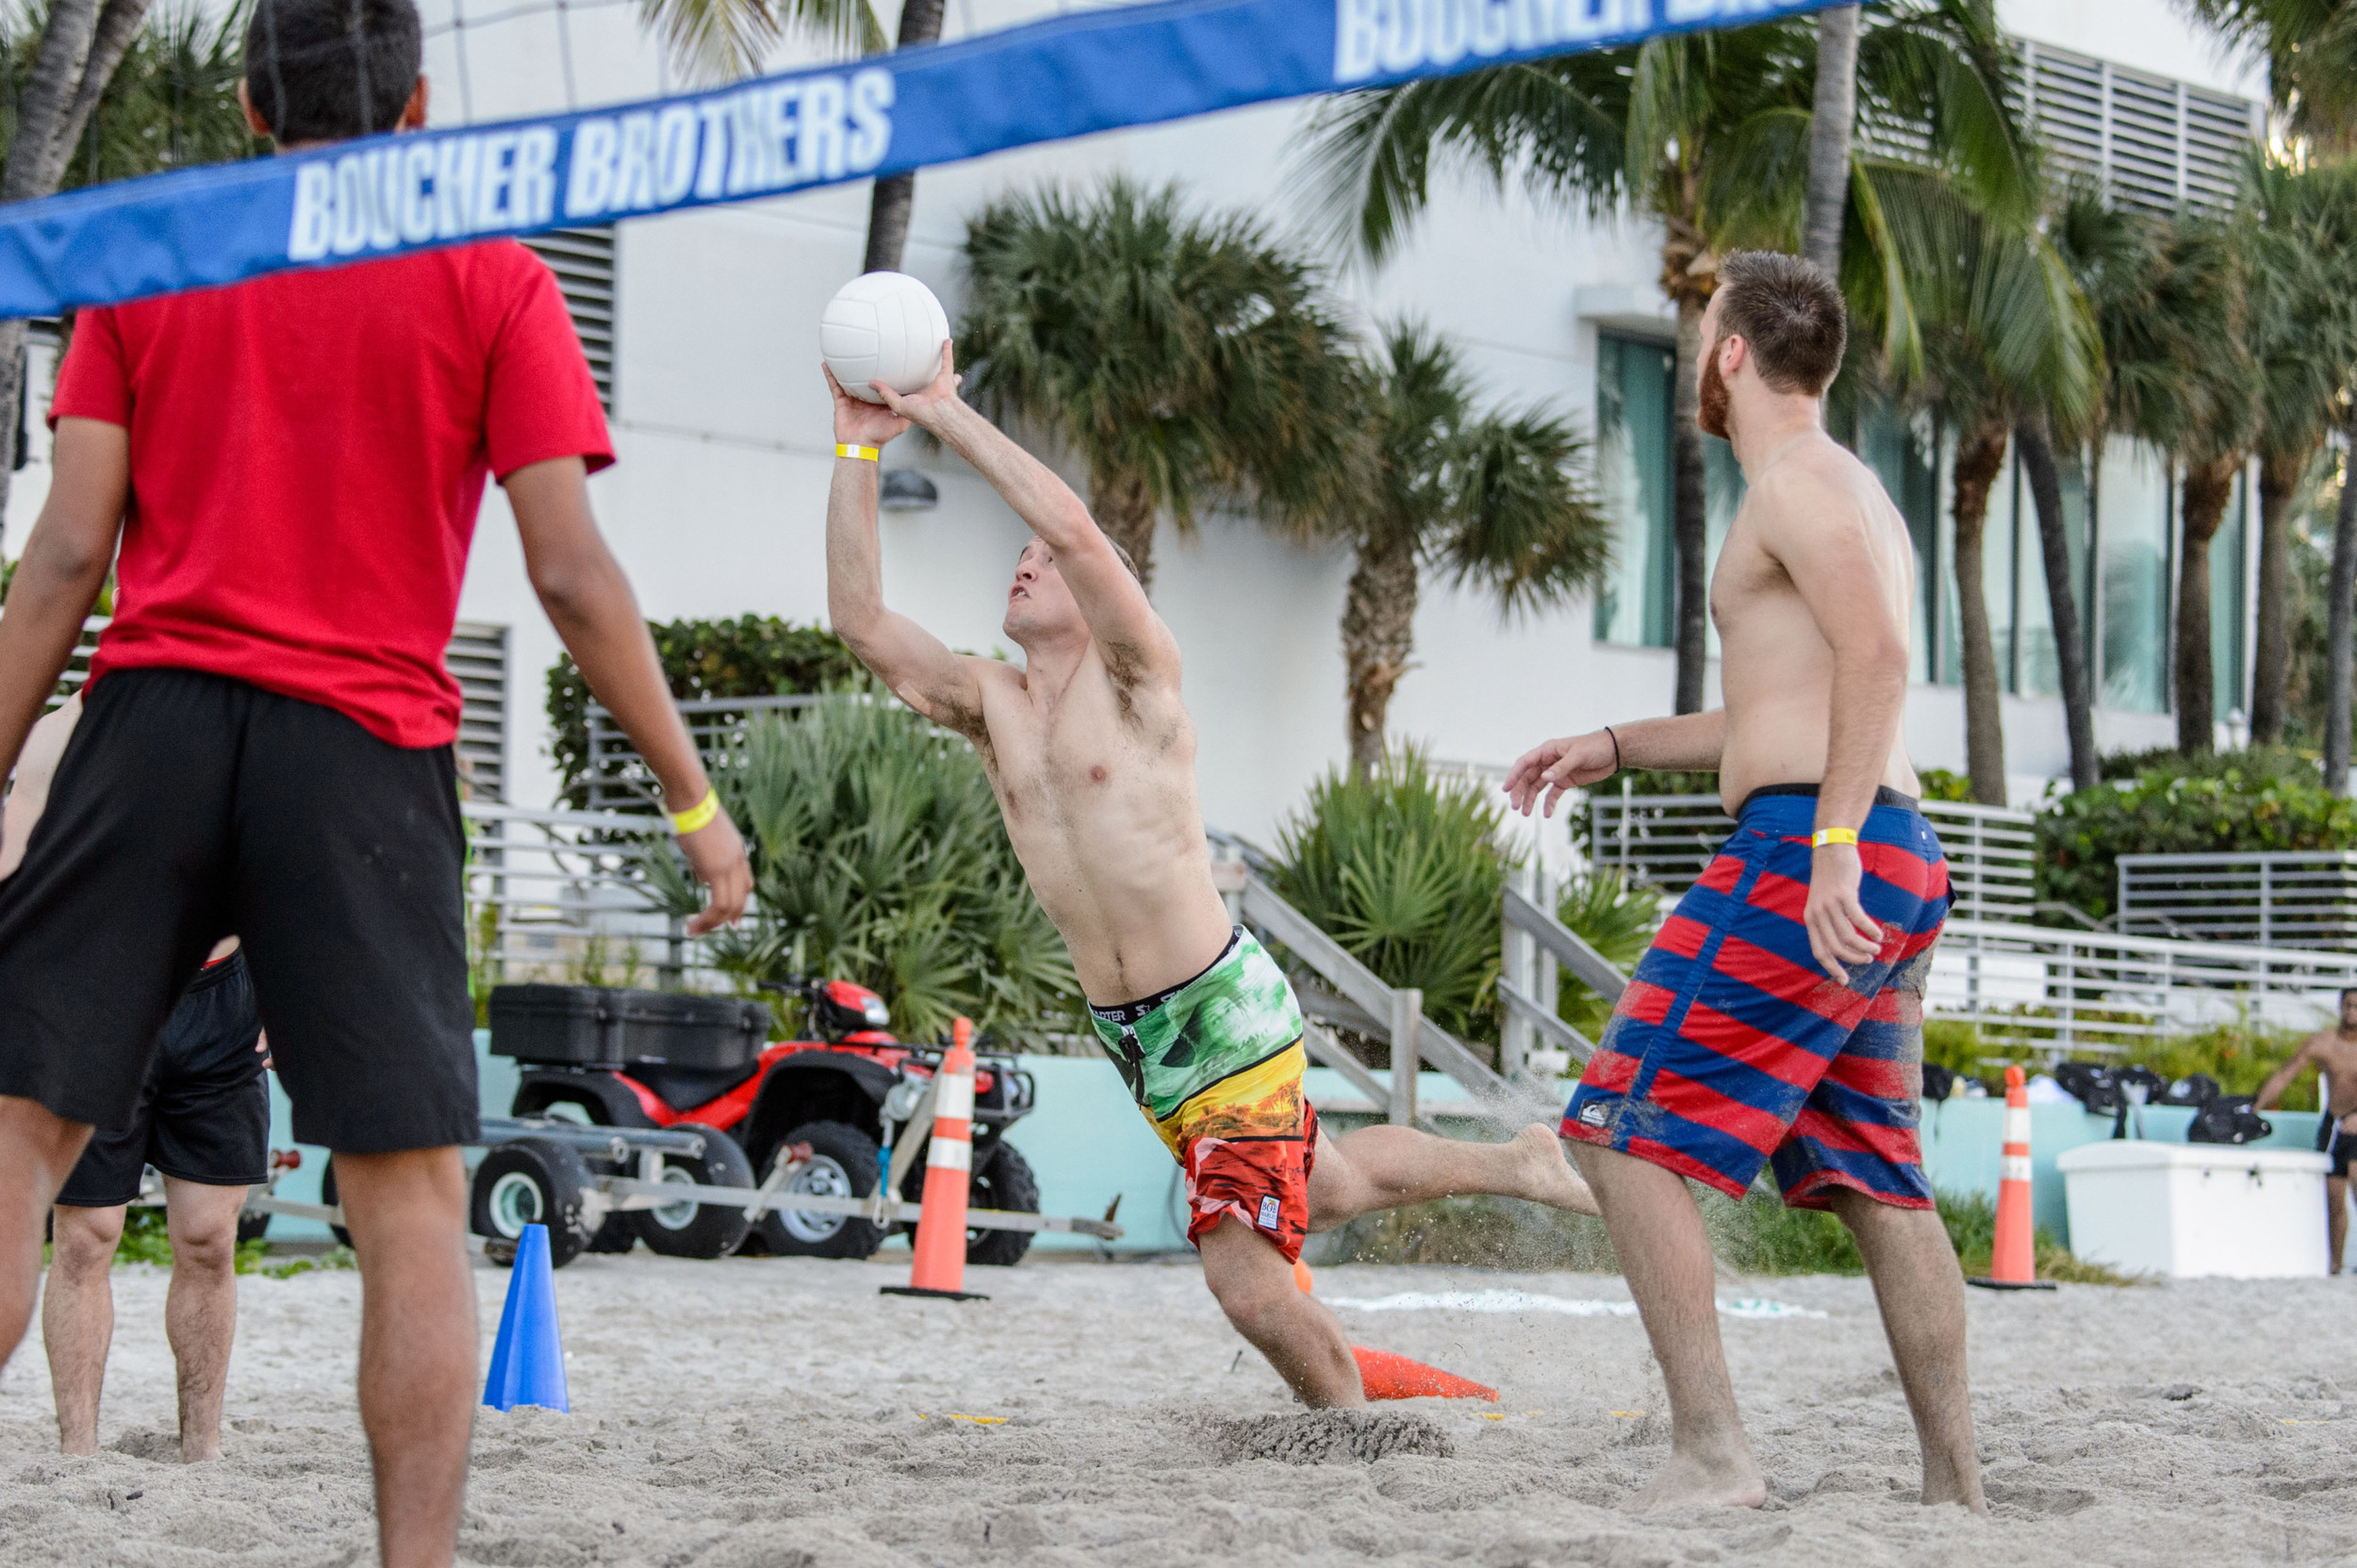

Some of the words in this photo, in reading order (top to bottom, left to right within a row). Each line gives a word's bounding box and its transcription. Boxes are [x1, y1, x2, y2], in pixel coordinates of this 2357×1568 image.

[1335, 0, 1649, 82] BOUC
[288, 126, 559, 261] BOUCHER
[567, 70, 896, 218] BROTHERS
[1261, 1201, 1277, 1214] BOB
